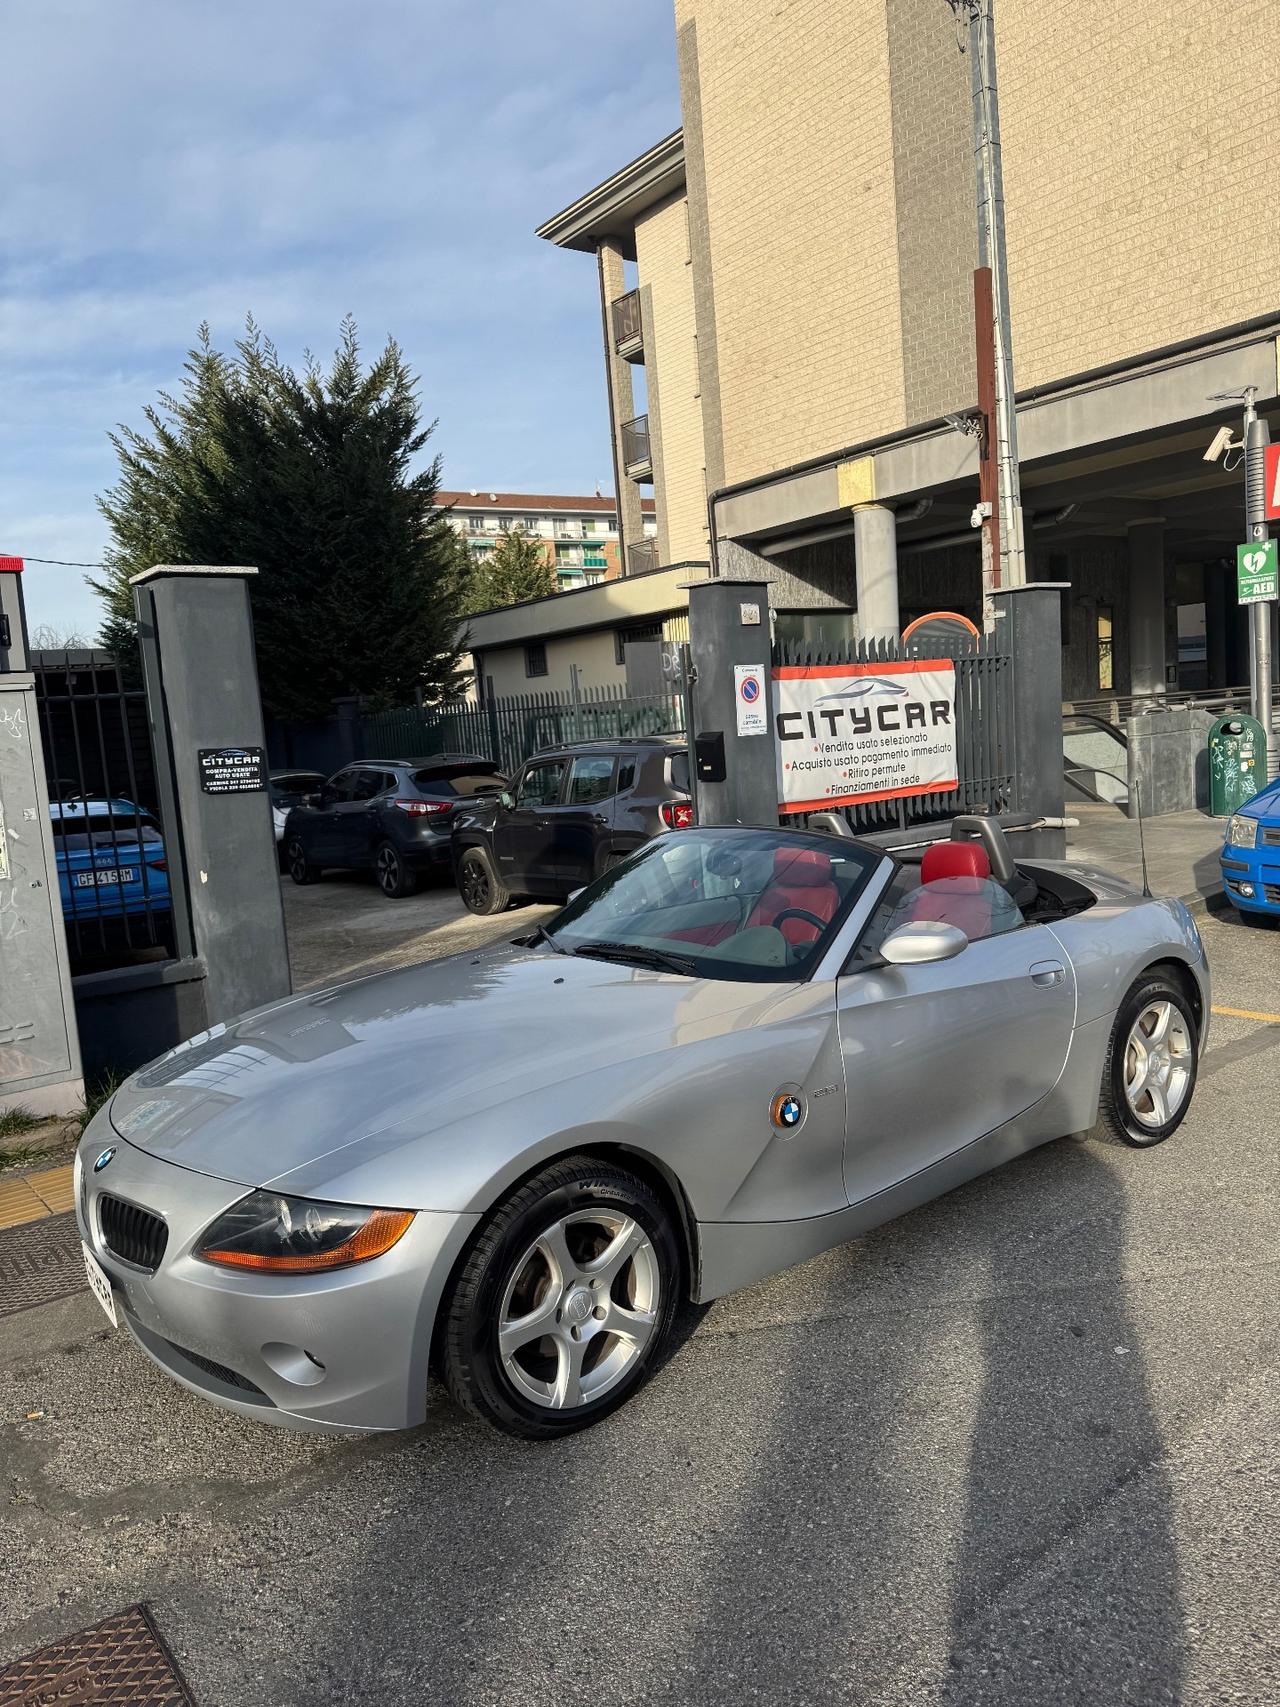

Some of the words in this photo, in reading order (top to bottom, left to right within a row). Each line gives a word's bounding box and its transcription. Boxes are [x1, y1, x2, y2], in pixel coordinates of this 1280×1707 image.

[1253, 582, 1275, 595] AED
[776, 700, 951, 741] CITYCAR
[818, 741, 854, 753] Vendita
[856, 738, 879, 749] usato
[880, 733, 928, 747] selezionato
[202, 756, 260, 766] CITYCAR
[791, 757, 832, 772] Acquisto
[834, 755, 860, 766] usato
[861, 749, 909, 766] pagamento
[911, 743, 952, 756] immediato
[848, 767, 870, 779] Ritiro
[871, 763, 906, 778] permute
[830, 780, 890, 795] Finanziamenti
[891, 777, 900, 786] in
[901, 774, 920, 785] sede
